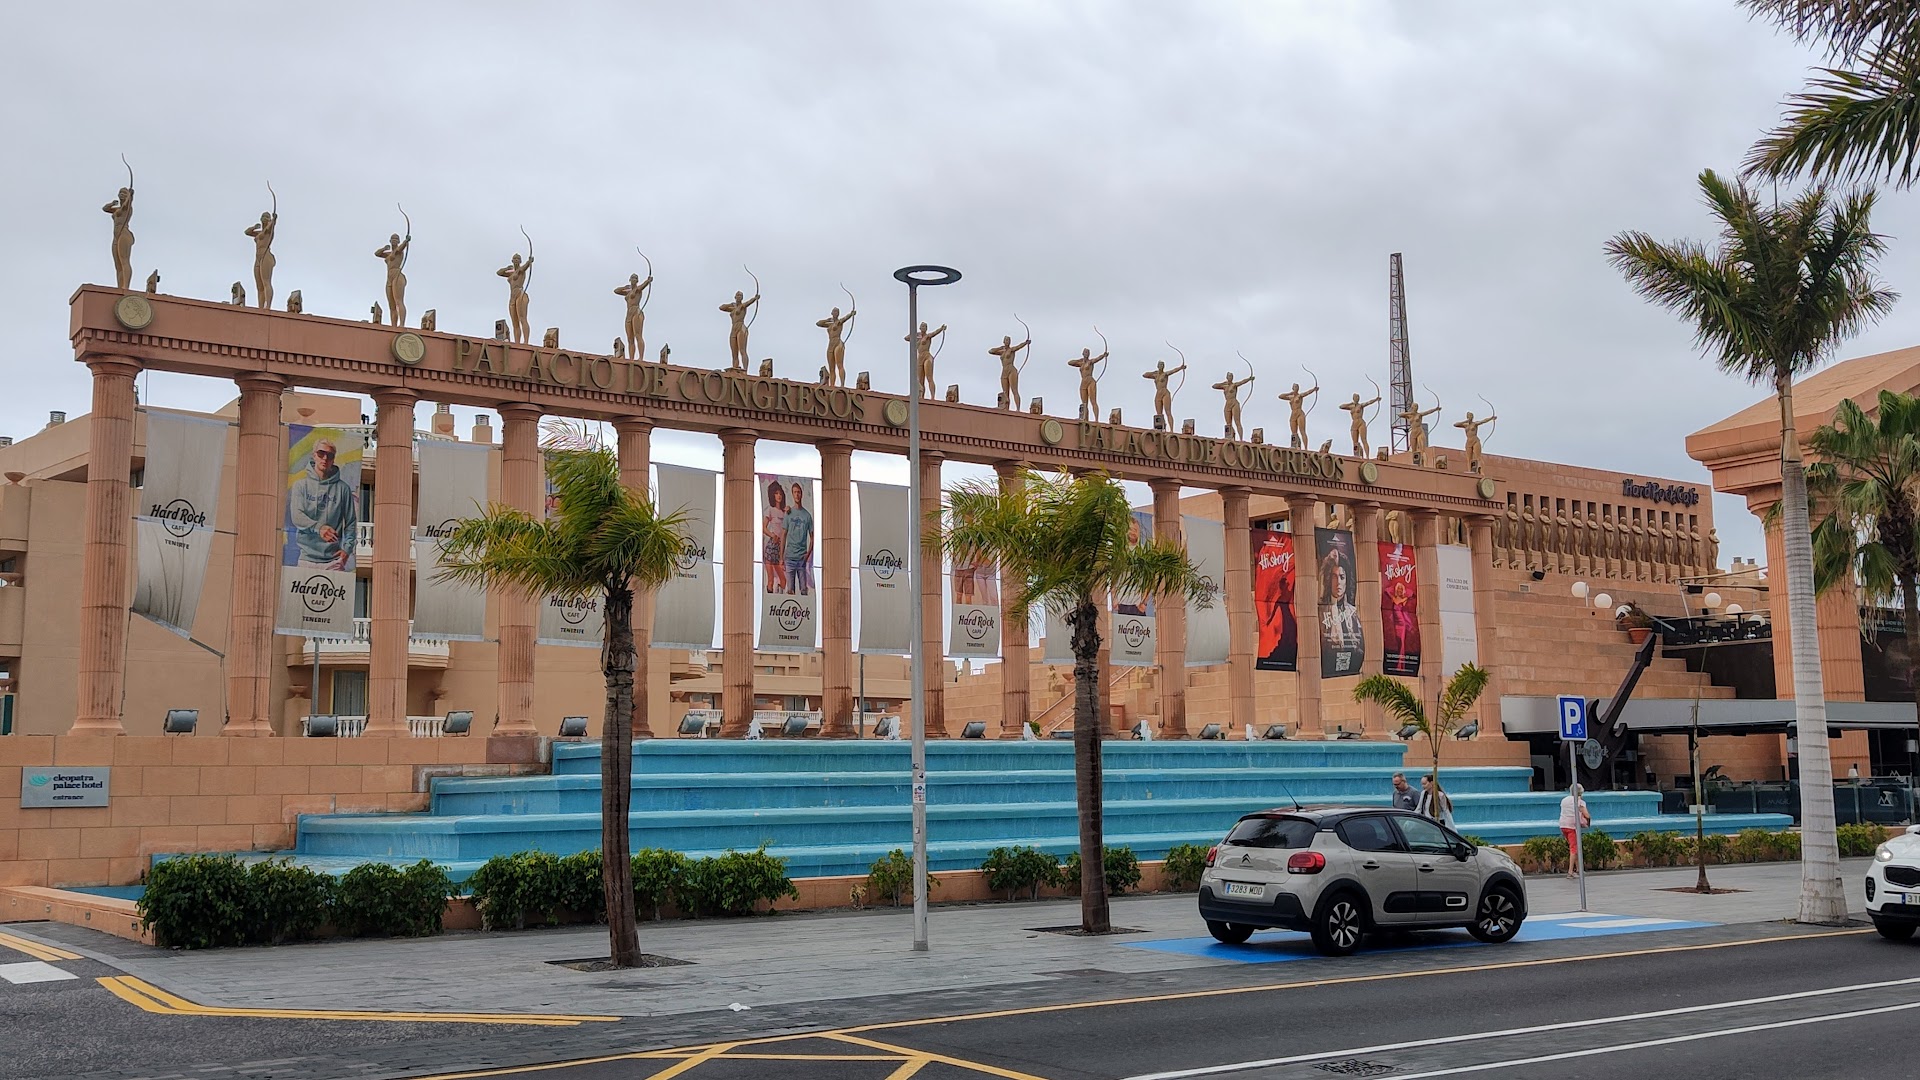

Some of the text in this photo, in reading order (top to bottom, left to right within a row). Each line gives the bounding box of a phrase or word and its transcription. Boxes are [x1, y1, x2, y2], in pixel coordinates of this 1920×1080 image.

[452, 338, 866, 422] PALACIO DE CONGRESOS
[1078, 421, 1345, 481] PALACIO DE CONGRESOS
[1622, 479, 1700, 508] Hard Rock Cafe
[150, 504, 206, 528] Hard Rock
[171, 524, 185, 532] CAFE
[685, 544, 707, 560] Rock
[866, 555, 903, 570] Hard Rock
[1258, 551, 1294, 573] History
[1385, 561, 1416, 584] History
[290, 580, 347, 601] Hard Rock
[549, 595, 598, 613] Hard Rock
[769, 604, 811, 620] Hard Rock
[302, 615, 331, 624] TENERIFE
[958, 614, 995, 629] Hard Rock
[560, 627, 585, 635] TENERIFE
[1117, 624, 1151, 638] Hard Rock
[1564, 701, 1582, 735] P
[53, 774, 94, 783] cleopatra
[53, 781, 103, 790] palace hotel
[1230, 884, 1263, 896] 3283 MDD
[1907, 894, 1920, 904] 31
